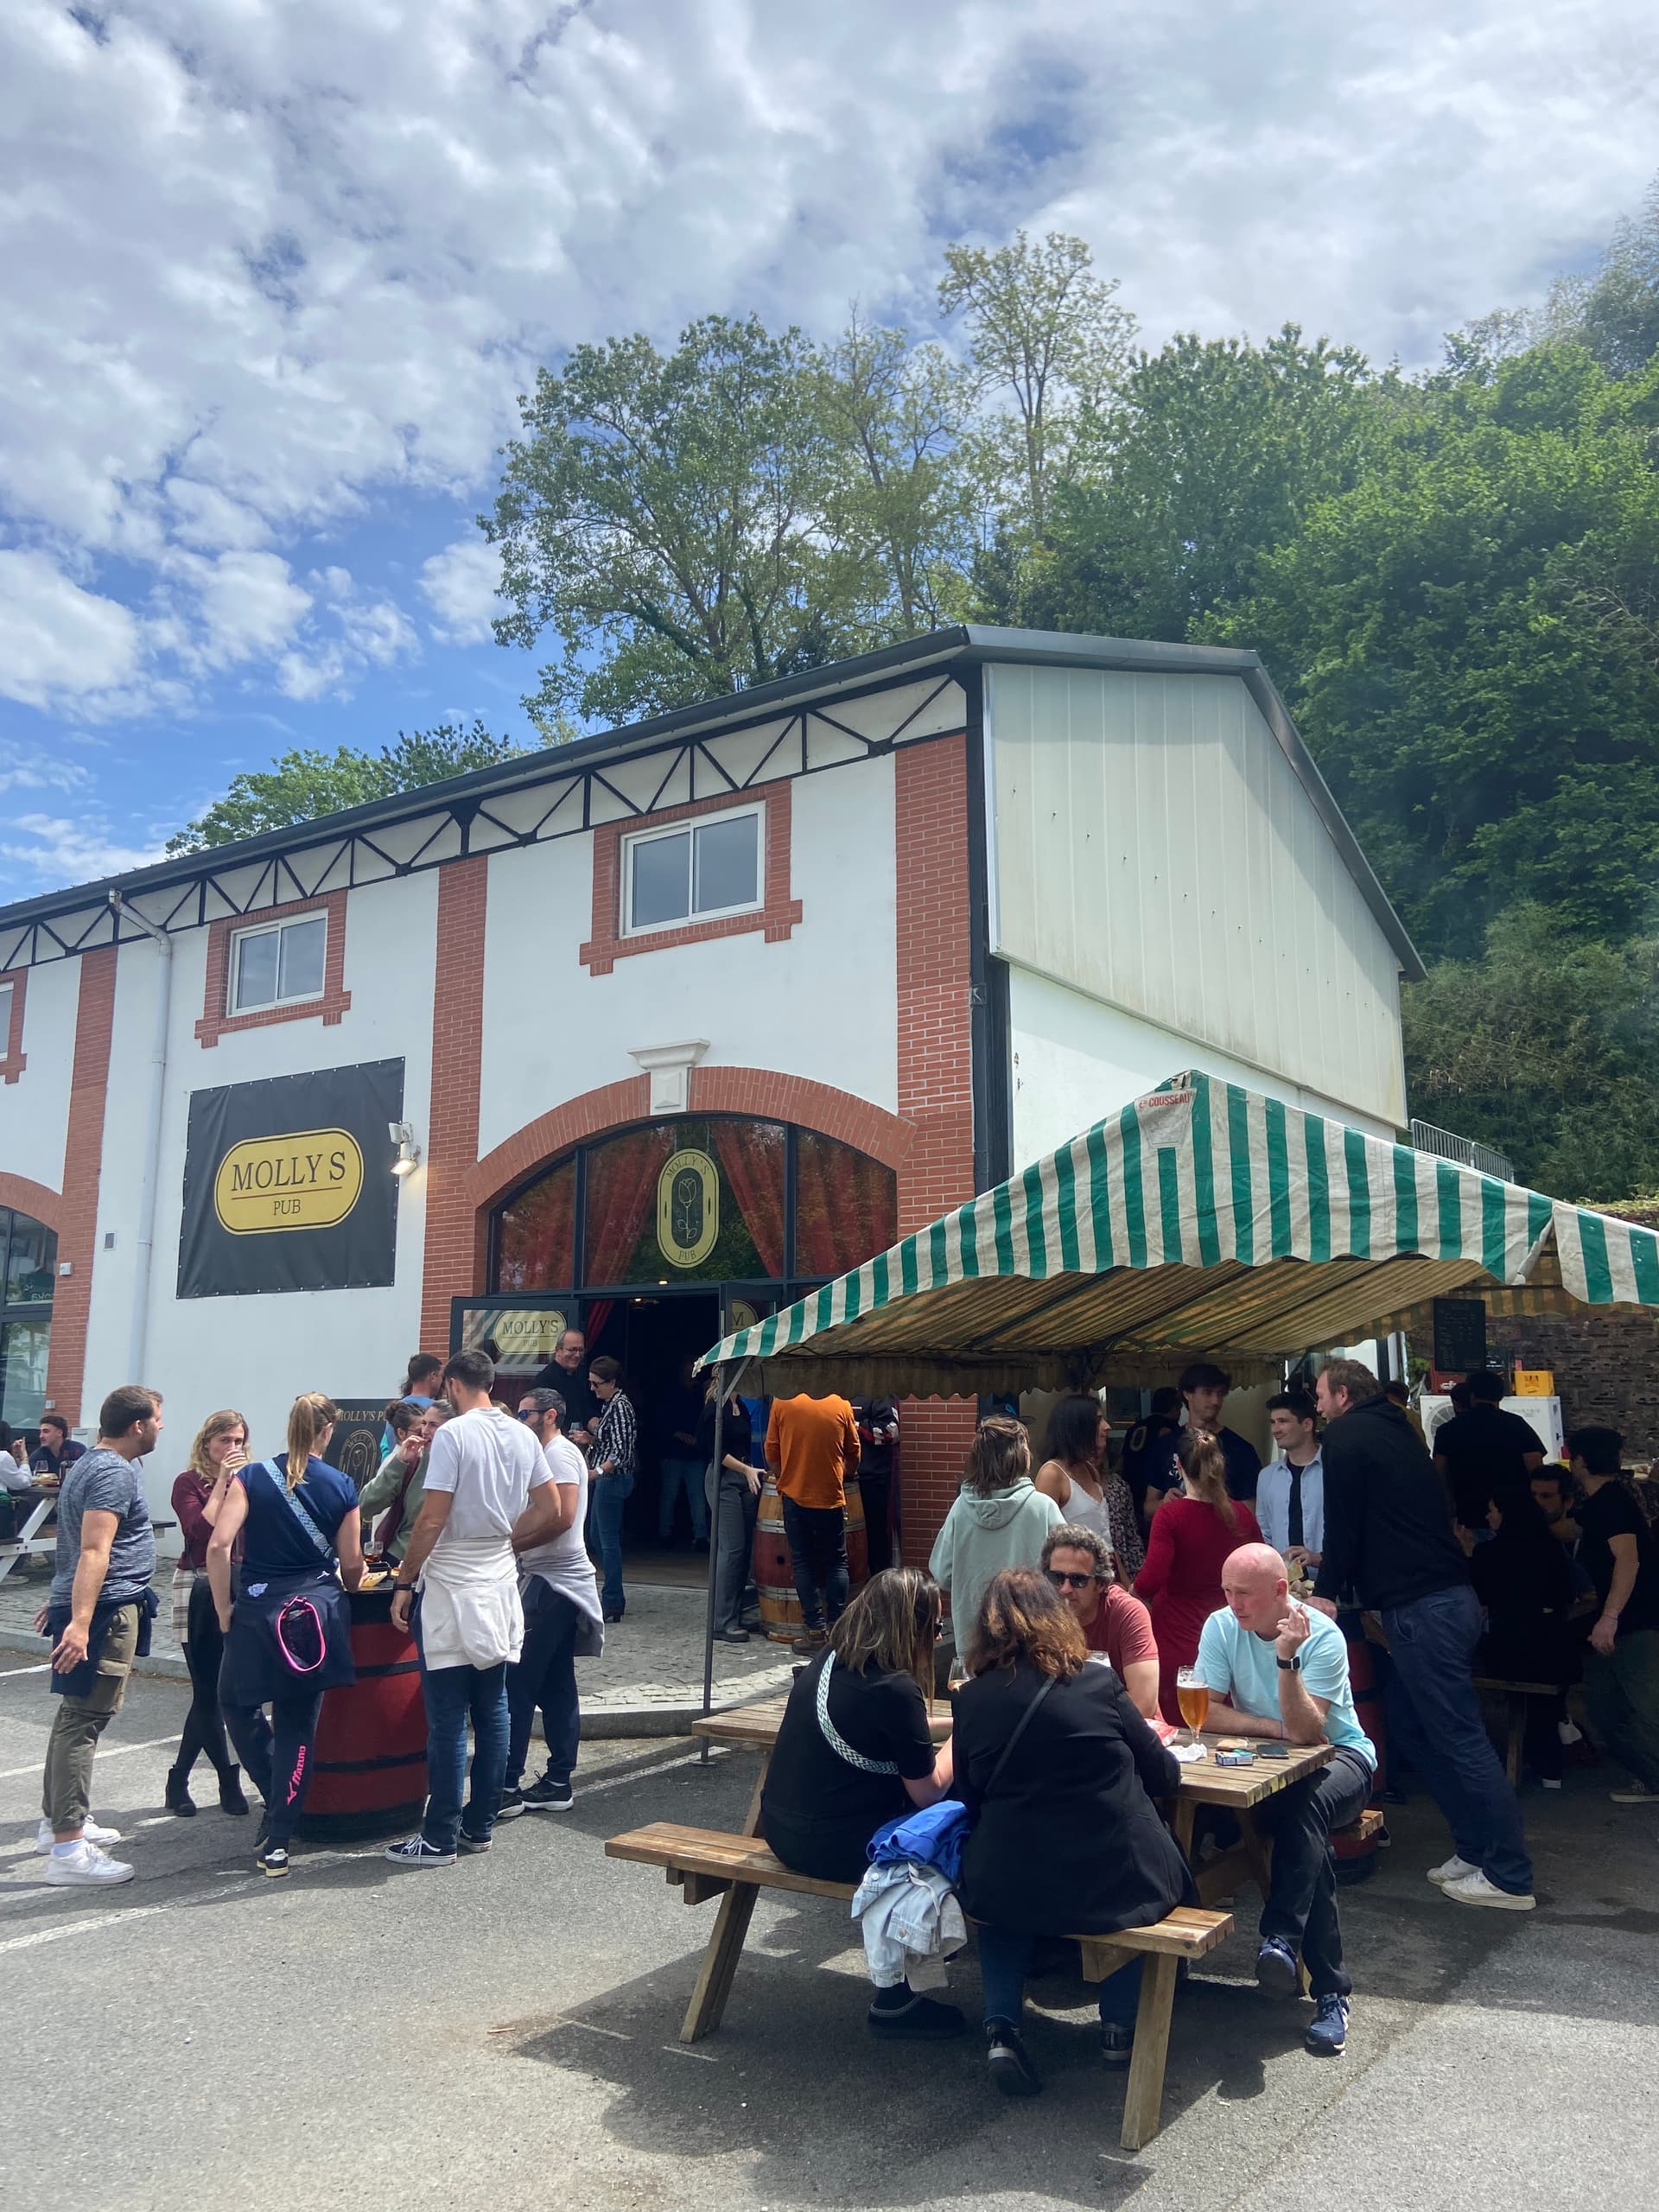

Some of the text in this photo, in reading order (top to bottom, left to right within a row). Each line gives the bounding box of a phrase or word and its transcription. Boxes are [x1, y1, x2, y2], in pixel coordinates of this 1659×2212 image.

[1149, 1092, 1190, 1107] COUSSEAU
[666, 1155, 709, 1179] MOLLY'S
[273, 1198, 301, 1216] PUB
[678, 1249, 696, 1261] PUB
[503, 1319, 559, 1335] MOLLY'S
